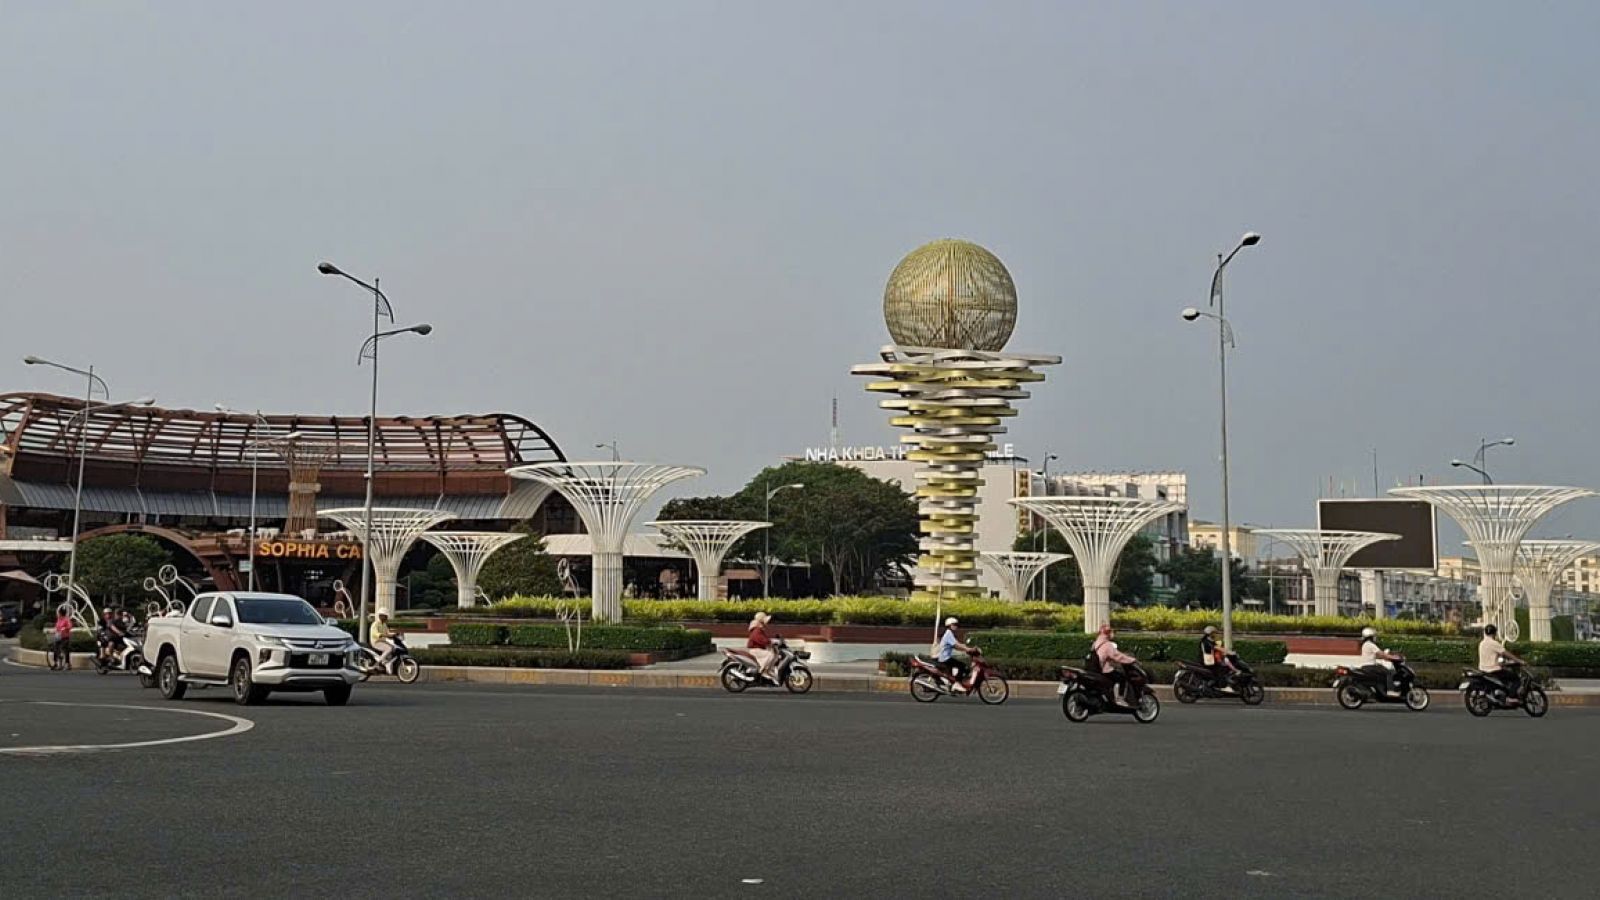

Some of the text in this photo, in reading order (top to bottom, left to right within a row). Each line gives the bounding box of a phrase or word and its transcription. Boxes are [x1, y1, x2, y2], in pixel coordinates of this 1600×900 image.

[805, 446, 838, 461] NHA
[842, 445, 886, 460] KHOA
[259, 542, 361, 559] SOPHIA CA
